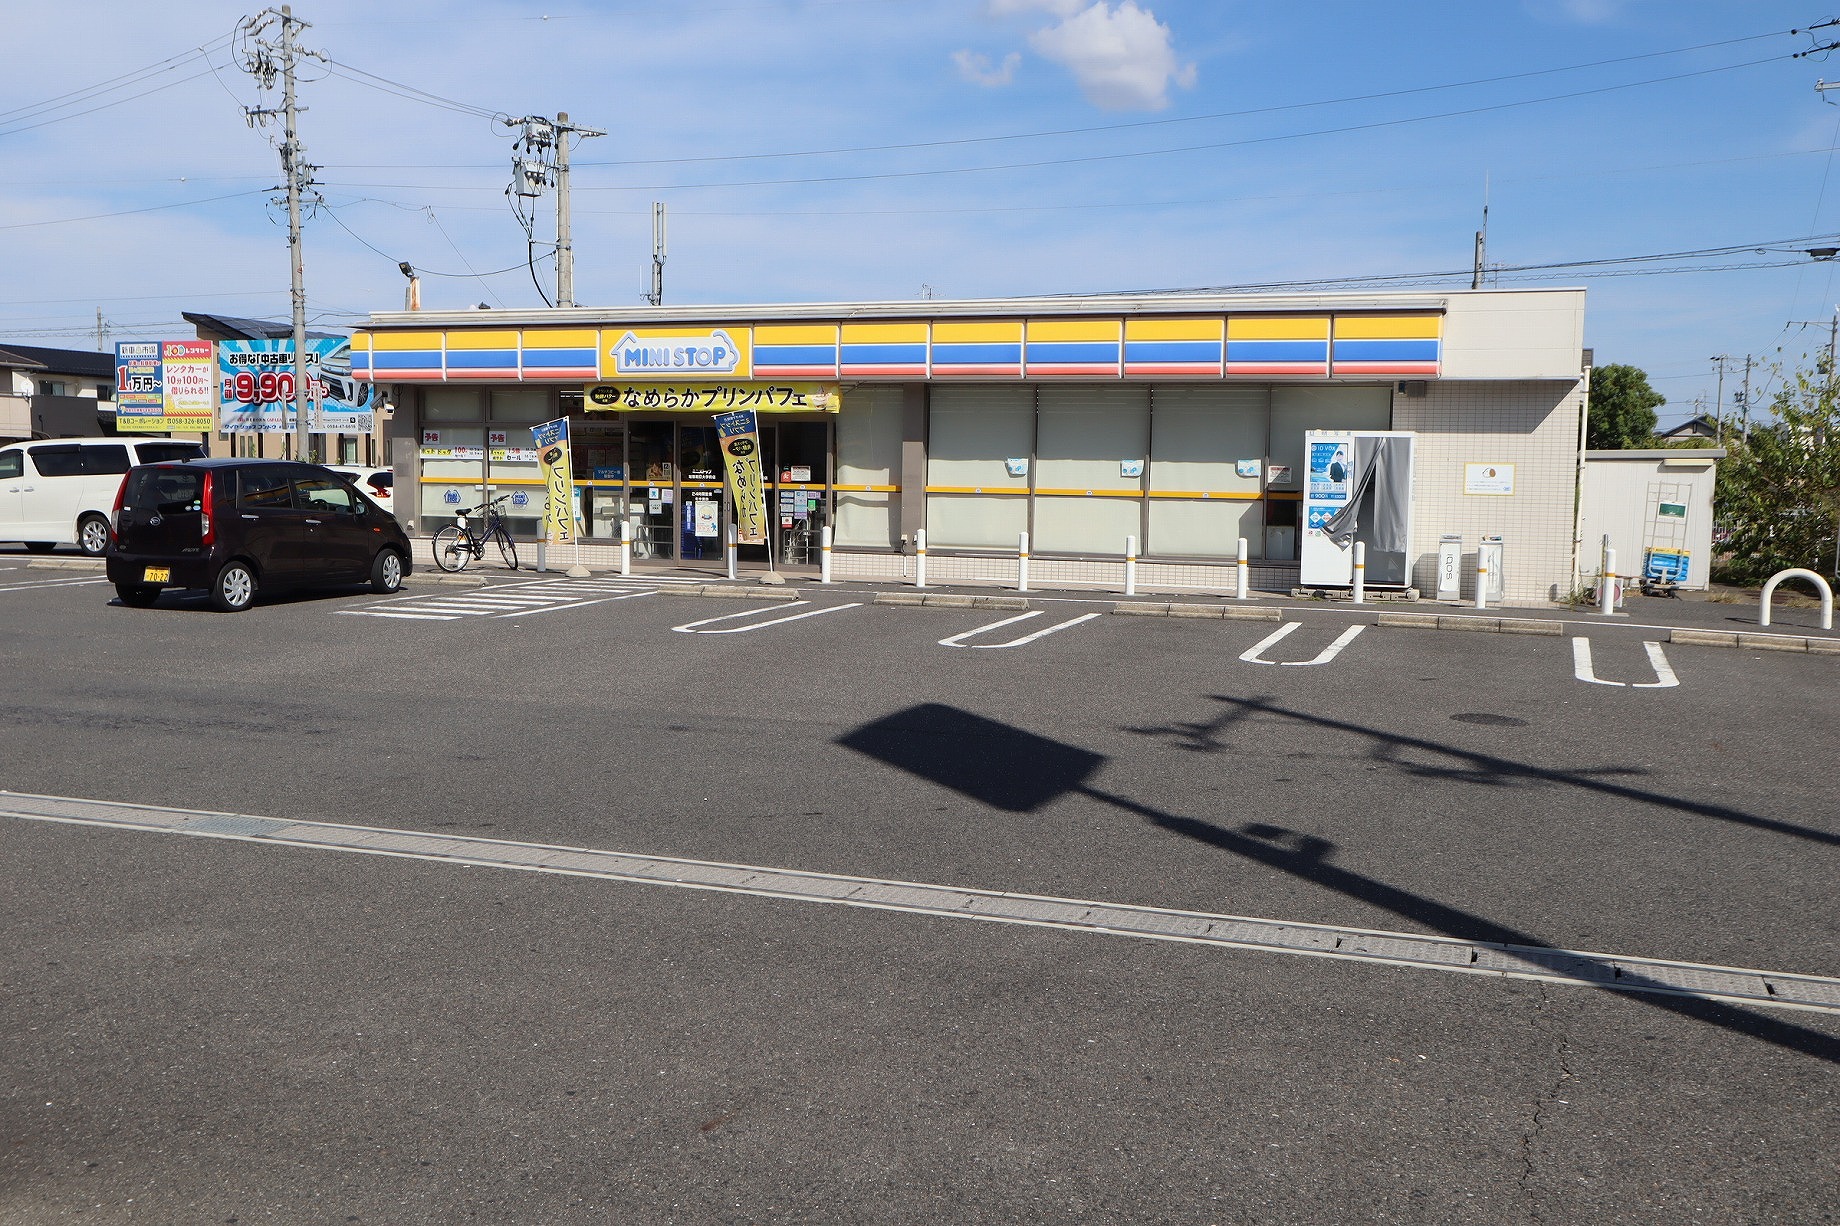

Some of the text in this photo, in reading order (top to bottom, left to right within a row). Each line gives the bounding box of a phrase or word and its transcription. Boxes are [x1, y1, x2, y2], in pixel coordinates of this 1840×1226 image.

[229, 353, 319, 365] お得な「中古車リス」
[624, 346, 727, 367] MINI STOP
[166, 365, 209, 374] レンタカーが
[623, 385, 808, 408] なめらかプリンパフェ
[1445, 553, 1454, 580] IQOS
